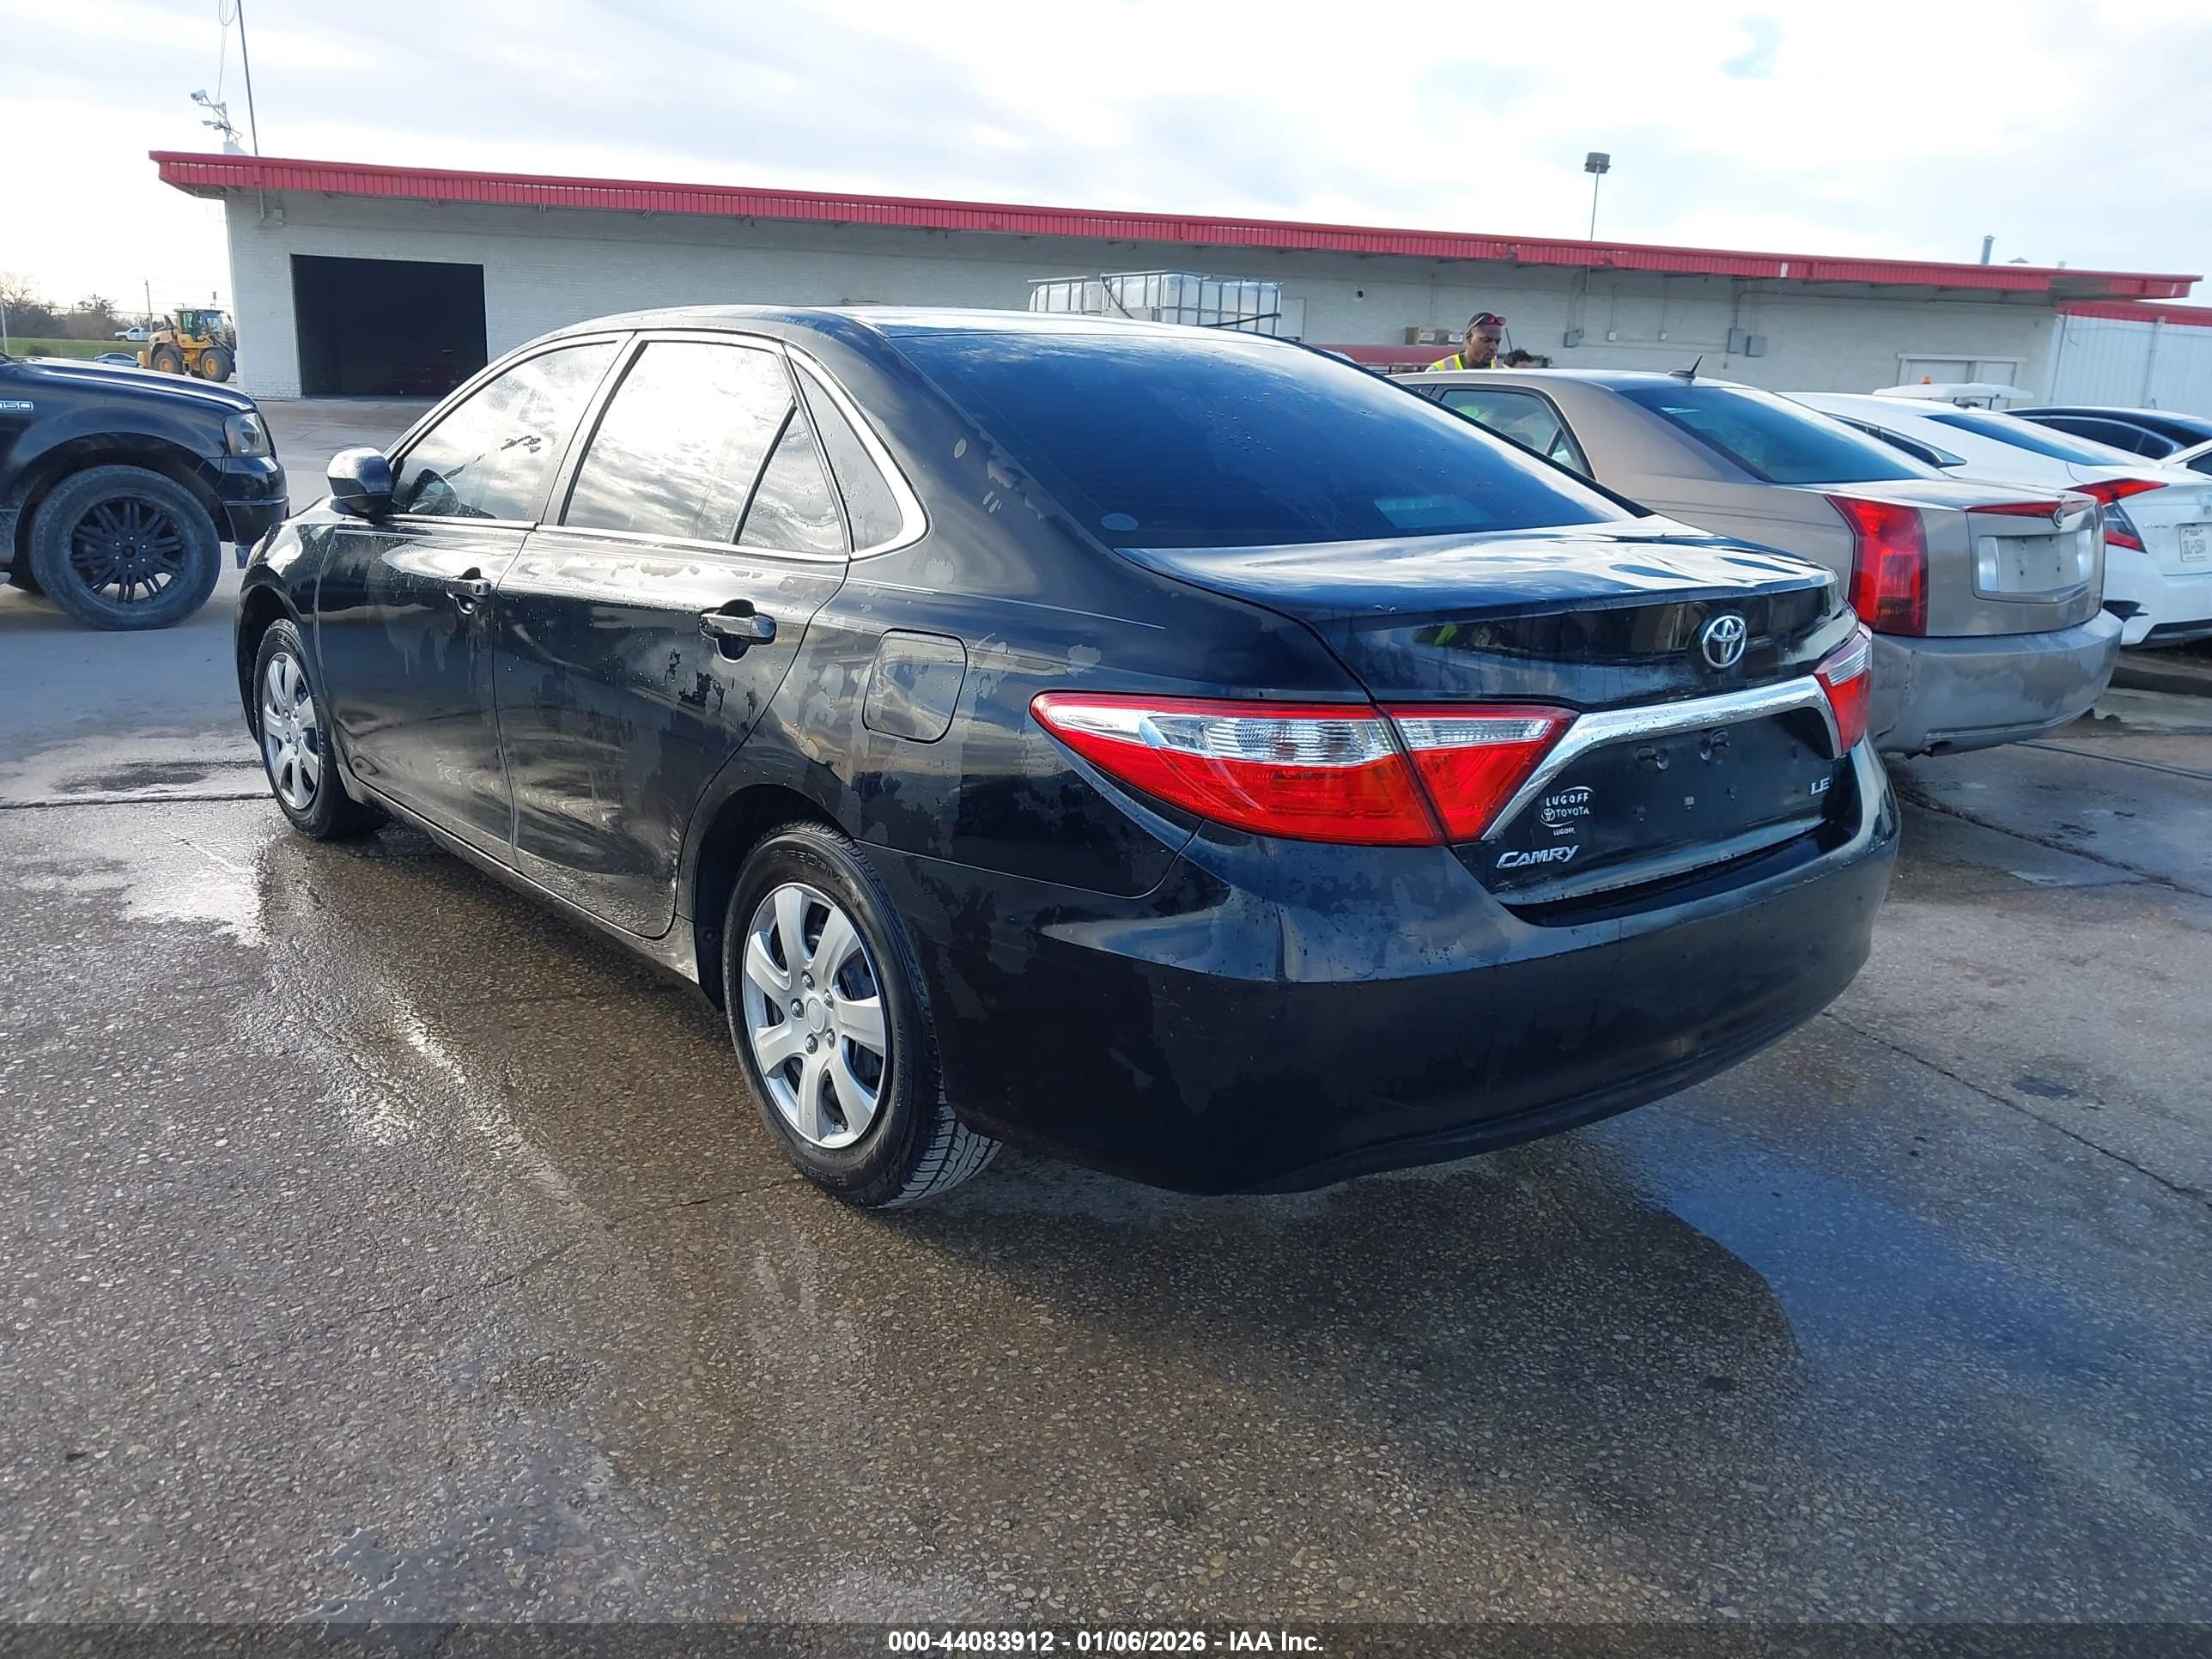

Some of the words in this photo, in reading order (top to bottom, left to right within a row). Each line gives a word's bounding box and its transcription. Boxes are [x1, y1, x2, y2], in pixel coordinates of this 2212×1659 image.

[1811, 776, 1830, 795] LE
[1546, 792, 1589, 806] LUGOFF
[1555, 806, 1589, 817] TOYOTA
[1496, 845, 1579, 868] CAMRY
